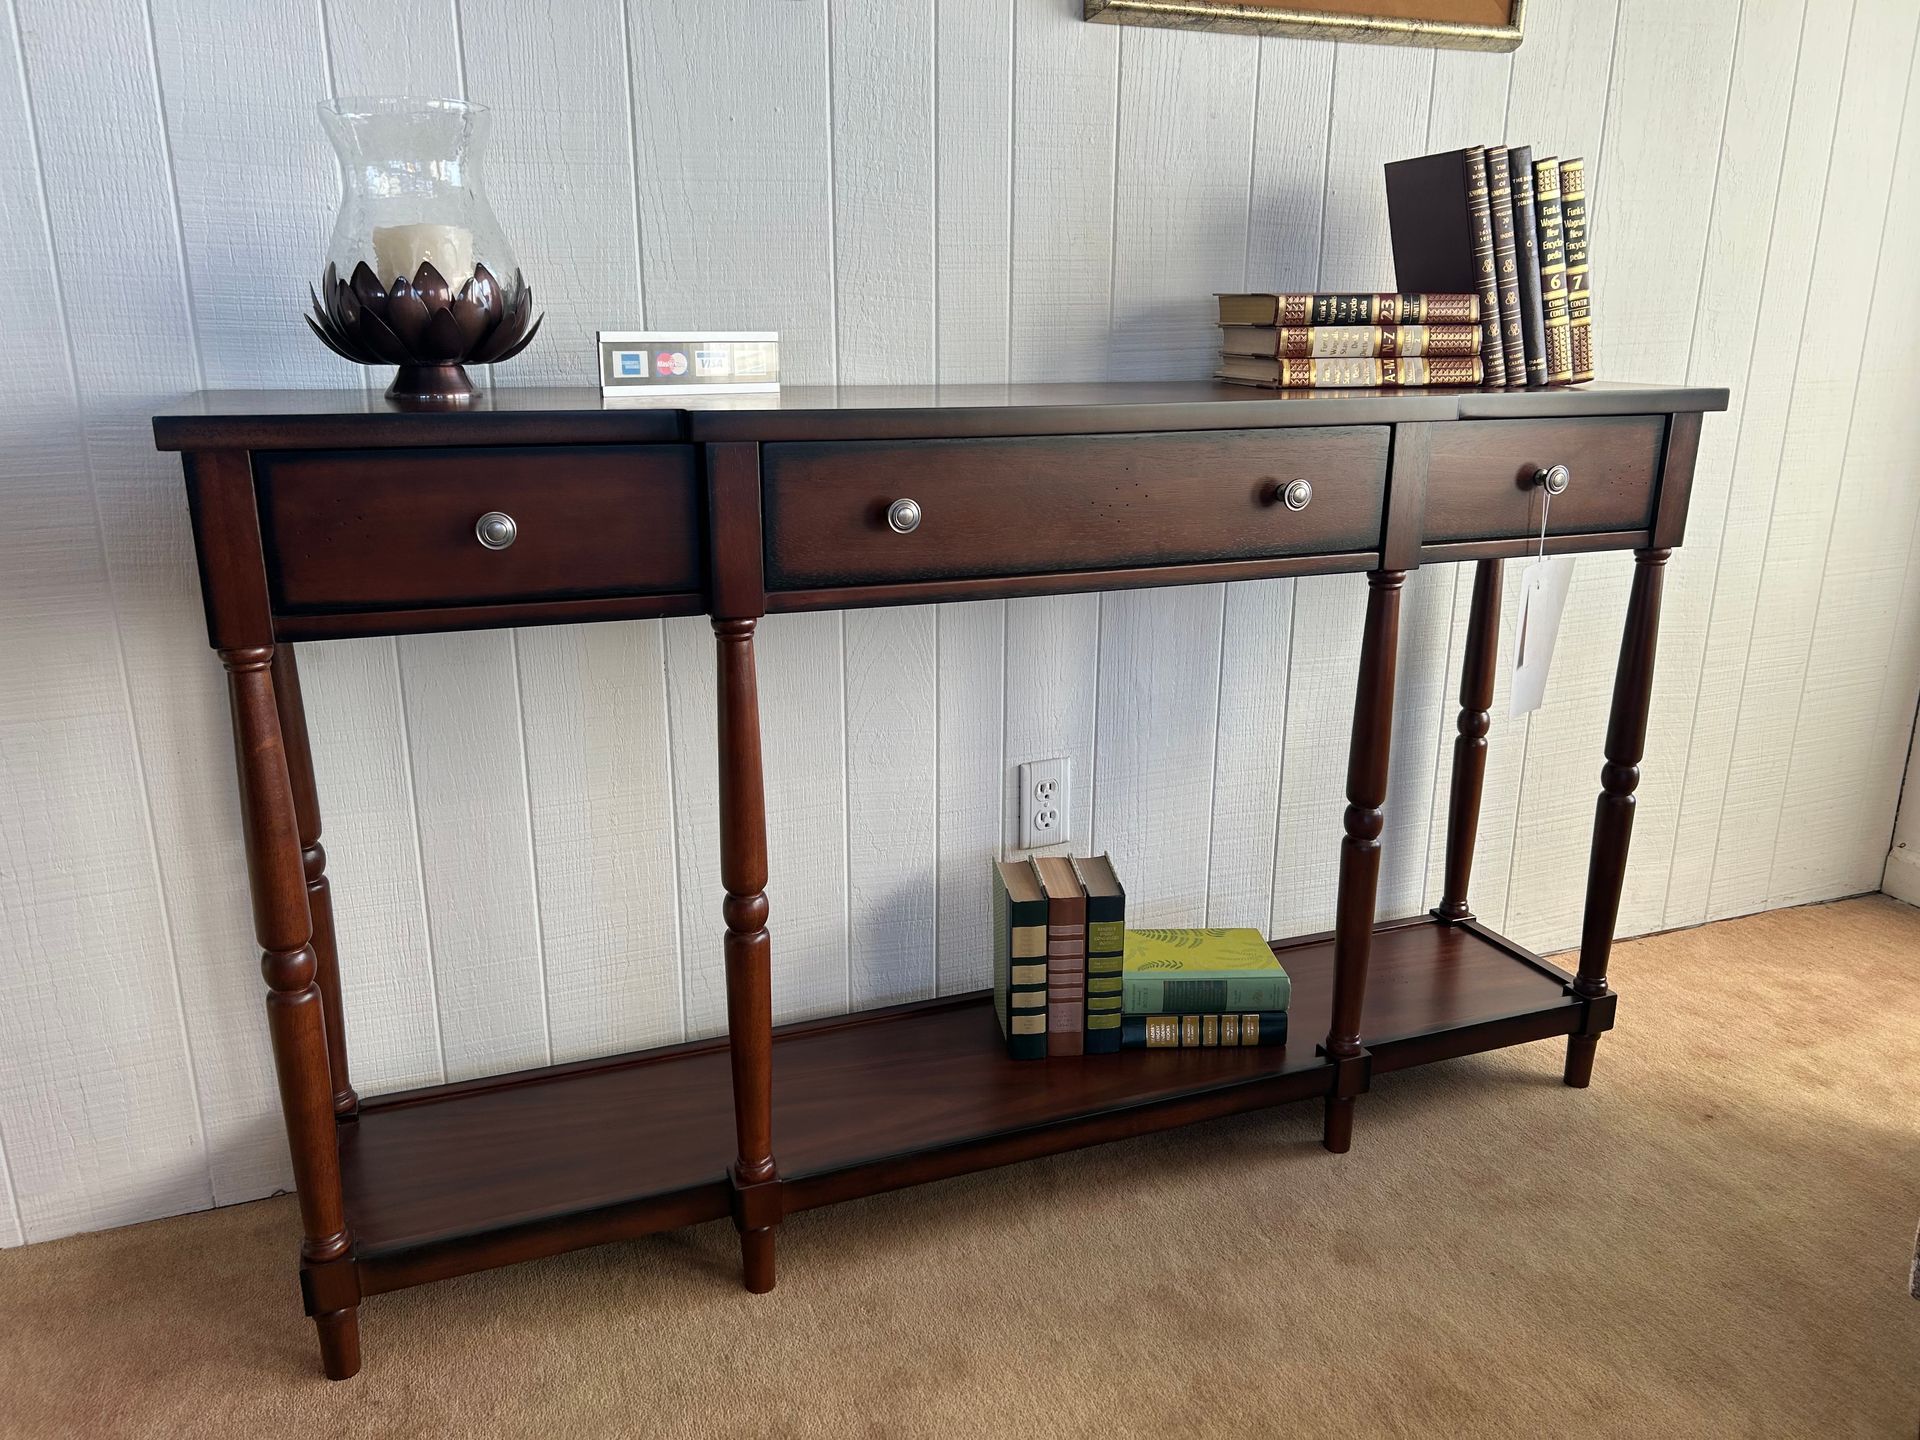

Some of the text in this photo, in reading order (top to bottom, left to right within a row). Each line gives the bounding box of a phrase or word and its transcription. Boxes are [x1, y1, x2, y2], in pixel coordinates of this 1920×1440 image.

[1567, 207, 1581, 217] Funk
[1526, 240, 1533, 248] 6
[1550, 274, 1561, 290] 6
[1572, 274, 1583, 290] 7
[1318, 305, 1327, 322] Funk
[1381, 299, 1394, 320] 23
[1382, 331, 1396, 352] N-Z
[701, 358, 723, 369] VISA
[1384, 359, 1396, 382] A-M
